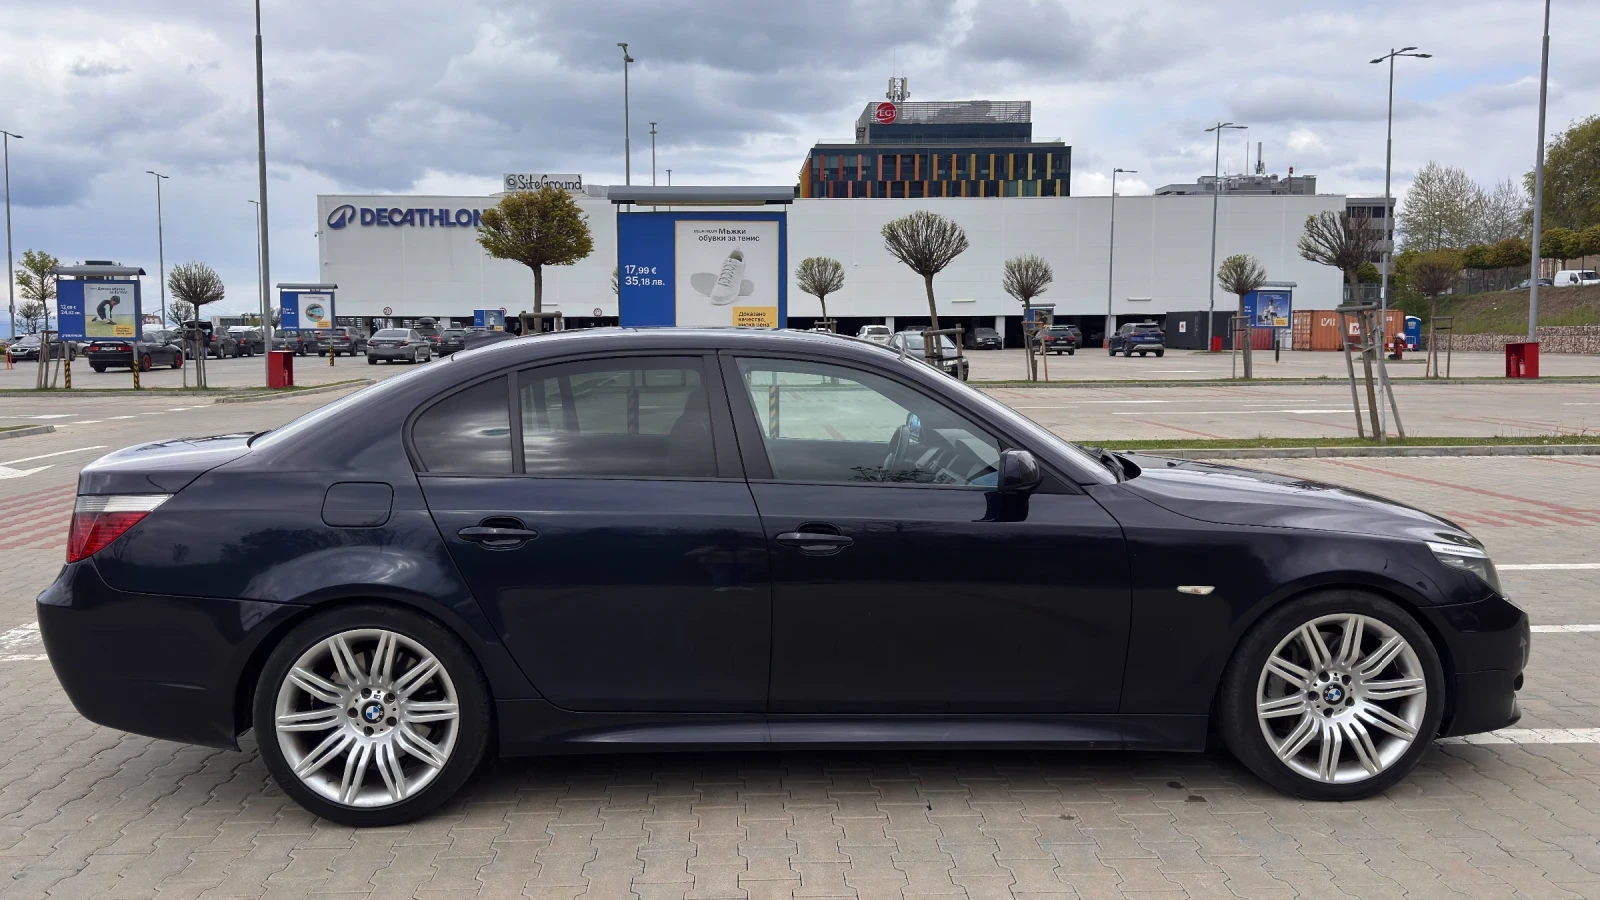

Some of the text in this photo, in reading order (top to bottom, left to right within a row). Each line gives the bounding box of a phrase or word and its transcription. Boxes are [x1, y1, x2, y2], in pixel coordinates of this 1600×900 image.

[879, 109, 896, 117] EGT
[517, 174, 582, 190] SiteGround
[360, 207, 487, 227] DECATHLON
[698, 234, 726, 243] обувки
[624, 264, 657, 276] 17,99 €
[624, 276, 651, 287] 35,18
